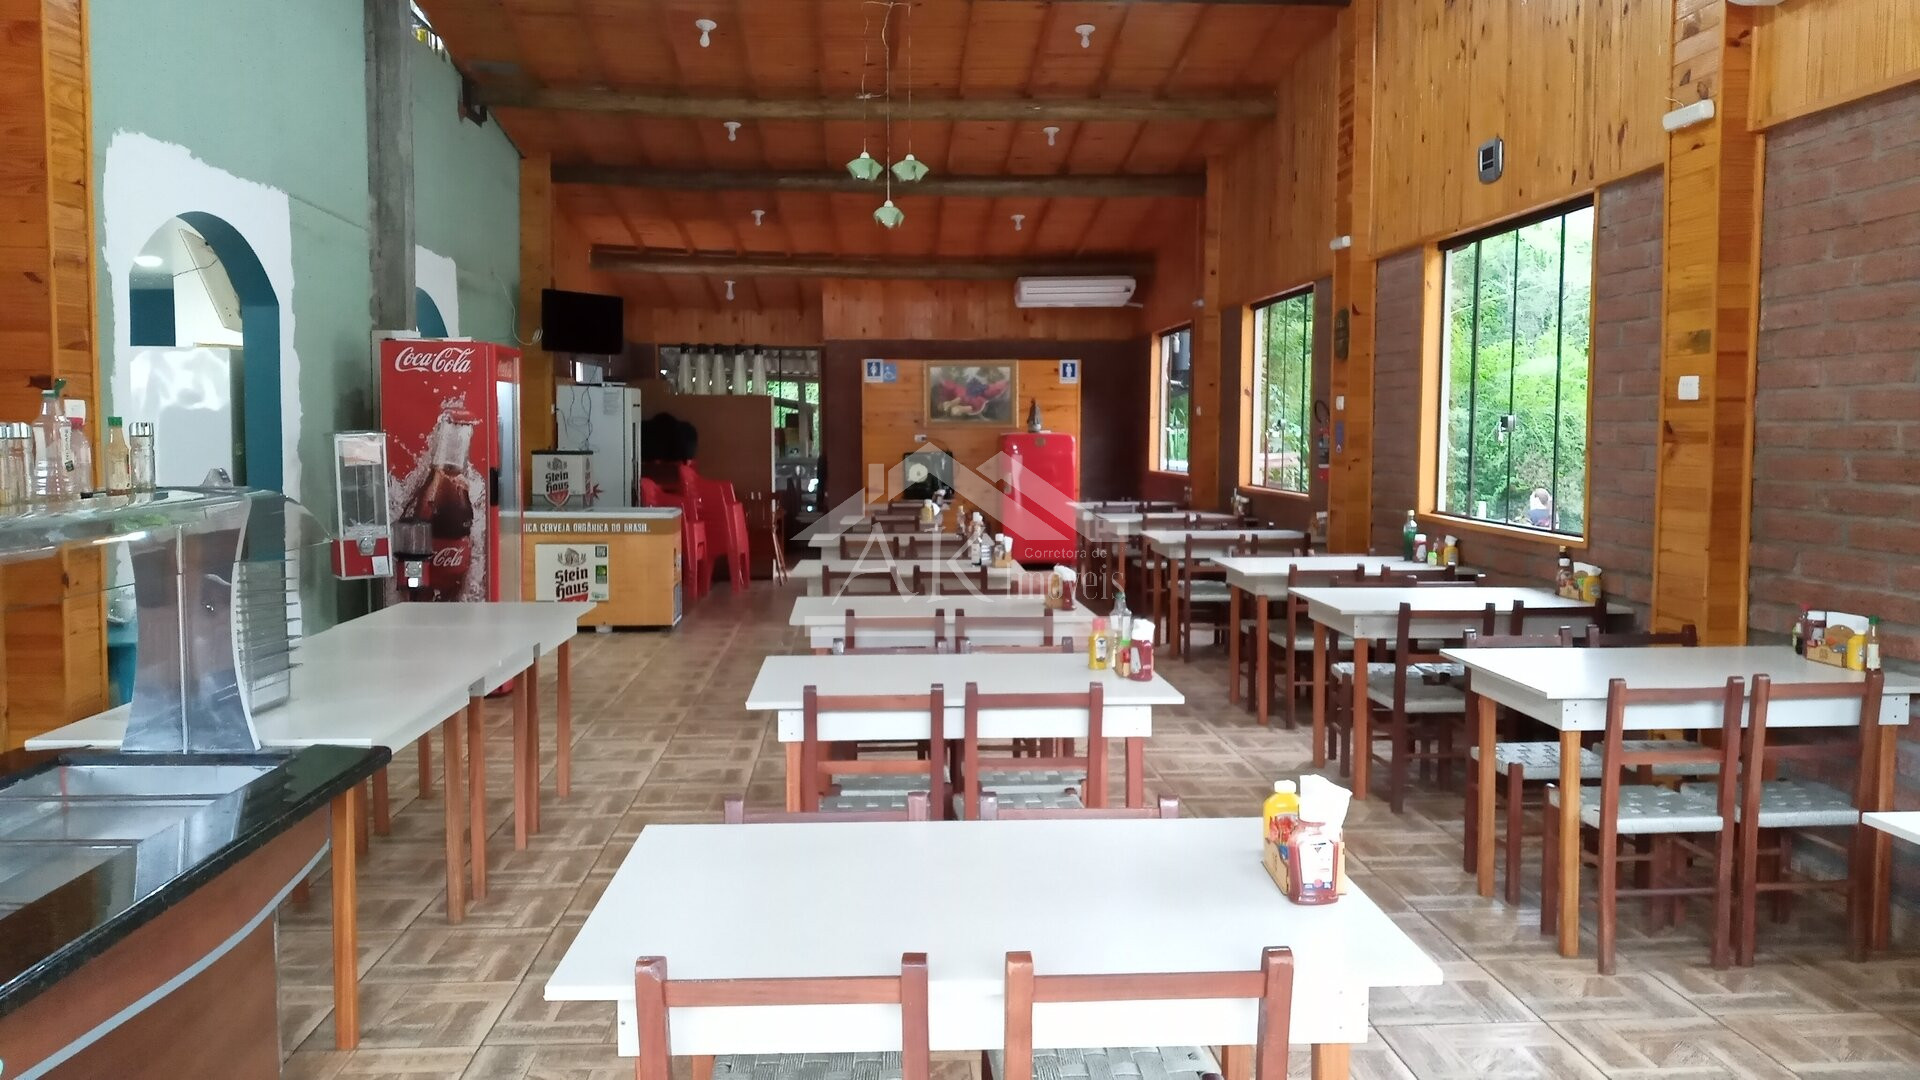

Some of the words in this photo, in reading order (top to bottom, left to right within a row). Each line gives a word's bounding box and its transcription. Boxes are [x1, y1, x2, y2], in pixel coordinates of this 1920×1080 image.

[395, 347, 475, 373] Coca-Cola
[545, 471, 569, 482] Stein
[540, 523, 570, 533] CERVEJA
[573, 521, 609, 533] ORGÂNICA
[611, 523, 621, 533] DO
[555, 567, 588, 583] Stein
